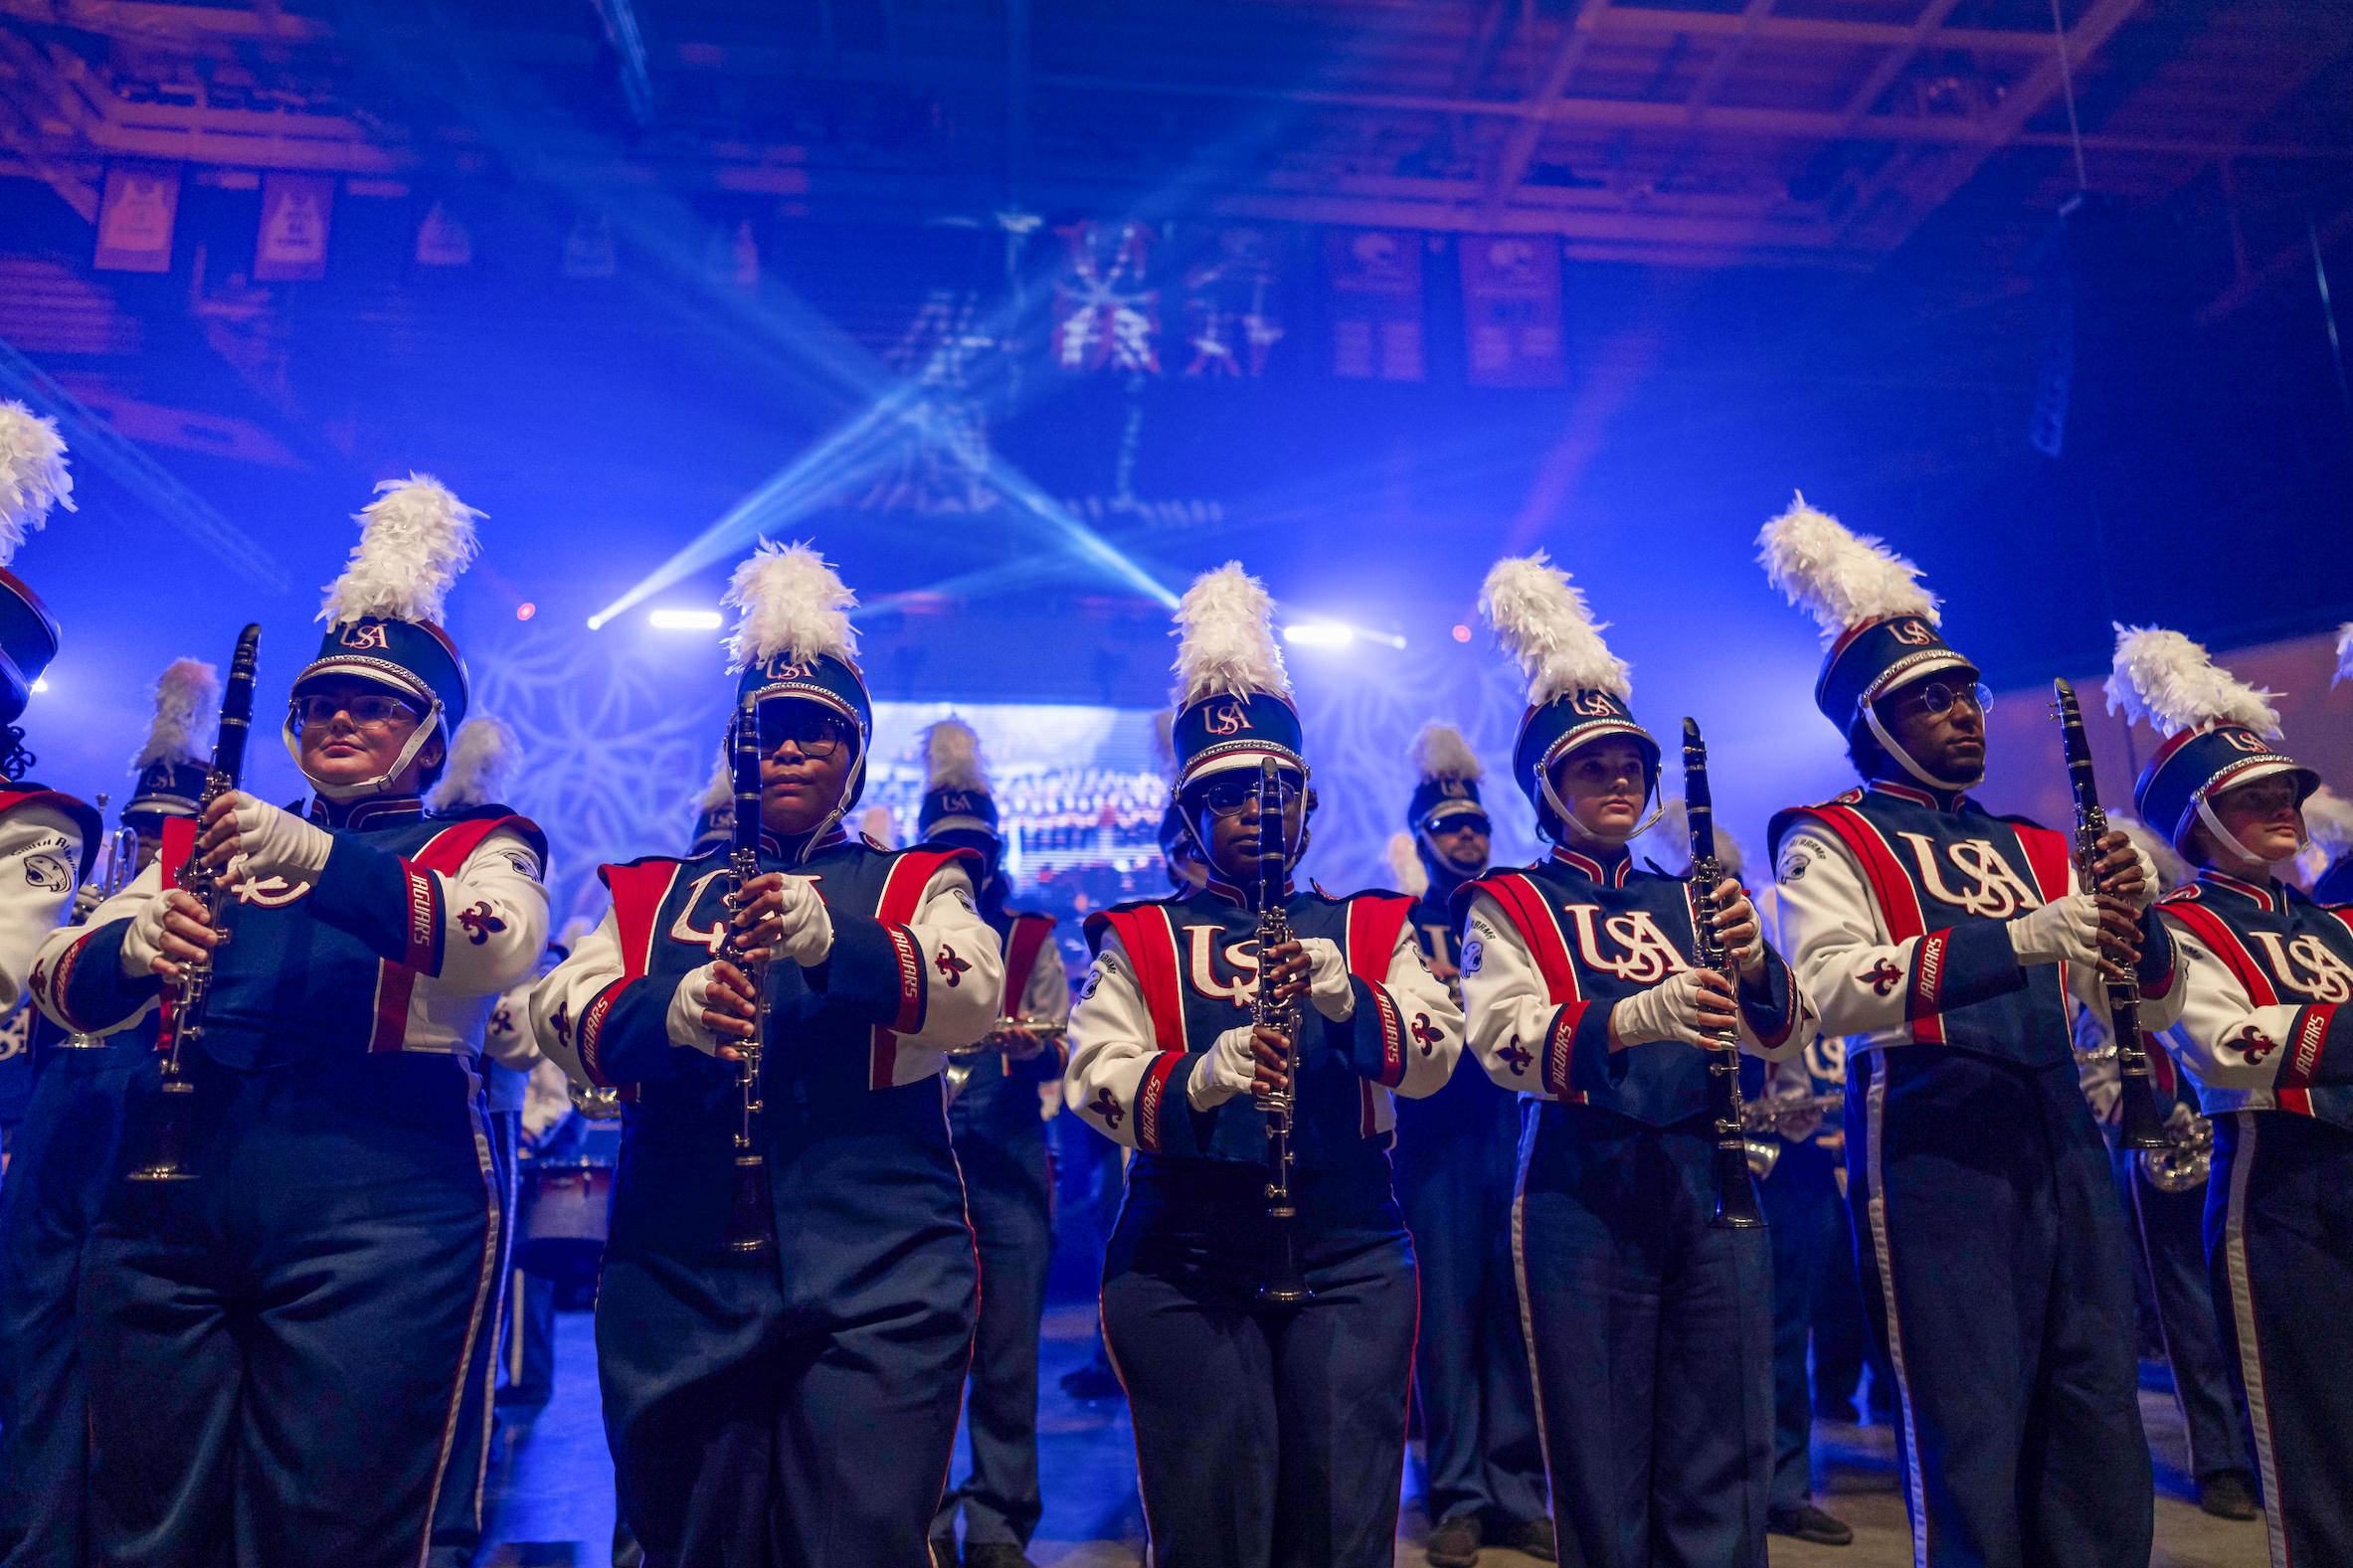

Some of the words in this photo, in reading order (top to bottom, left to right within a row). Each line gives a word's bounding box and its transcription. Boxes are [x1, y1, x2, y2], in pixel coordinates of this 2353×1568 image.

[338, 620, 391, 649] USA
[1886, 620, 1940, 644] USA
[1201, 701, 1255, 735] USA
[1565, 694, 1623, 716] USA
[2220, 732, 2274, 753] USA
[410, 871, 430, 947] JAGUARS
[1896, 831, 2045, 918] USA
[887, 927, 918, 998] JAGUARS
[1564, 904, 1695, 982] USA
[1919, 938, 1942, 1003] JAGUARS
[2248, 931, 2353, 1003] USA
[584, 996, 609, 1069] JAGUARS
[1373, 988, 1399, 1064] JAGUARS
[1551, 1021, 1572, 1091] JAGUARS
[2294, 1012, 2325, 1080] JAGUARS
[1142, 1074, 1162, 1148] JAGUARS
